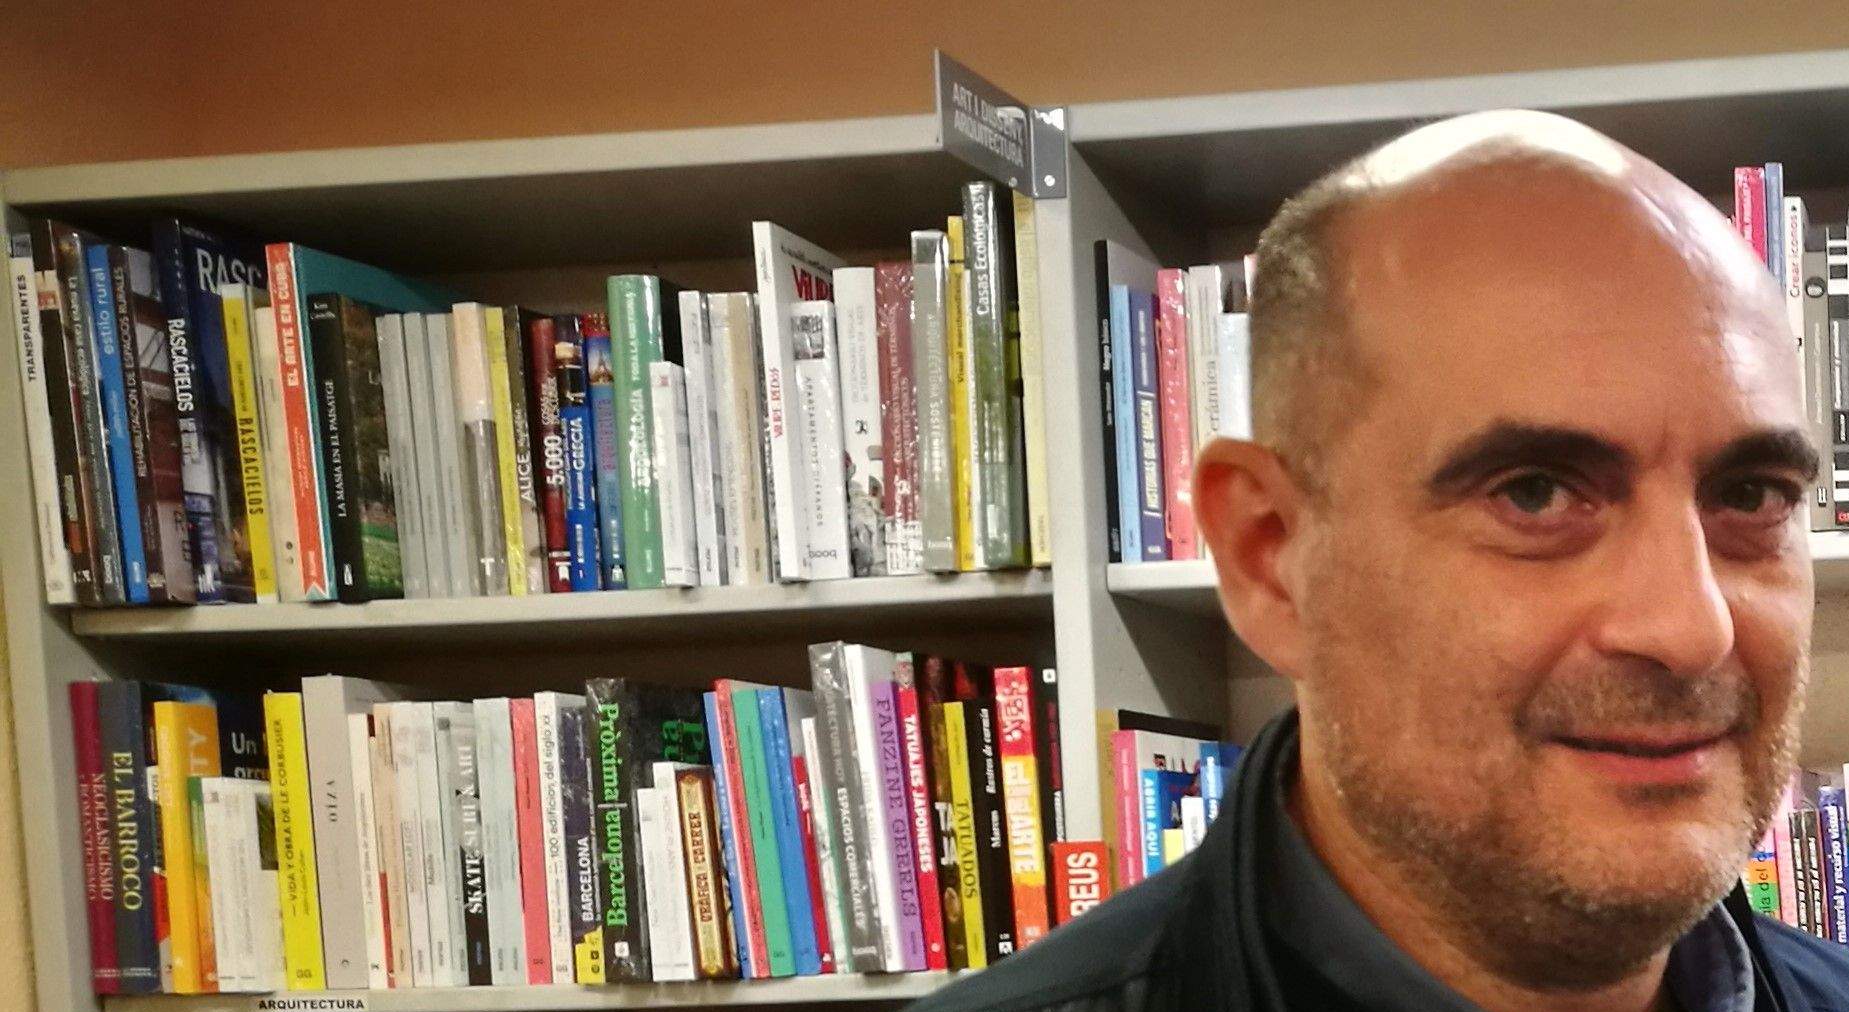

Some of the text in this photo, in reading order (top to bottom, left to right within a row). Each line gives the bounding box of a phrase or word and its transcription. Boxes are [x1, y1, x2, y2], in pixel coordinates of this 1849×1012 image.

[976, 273, 990, 315] Casas
[1790, 256, 1801, 298] Crear
[17, 274, 37, 382] TRANSPARENTES
[101, 309, 116, 356] estilo
[167, 317, 195, 412] RASCACIELOS
[238, 417, 264, 516] RASCACIELOS
[543, 434, 565, 486] 5.000
[572, 416, 586, 471] GRECIA
[517, 451, 536, 504] ALICE
[875, 697, 918, 917] FANZINE GRRRLS
[903, 713, 935, 873] TATUAJES JAPONESES
[1825, 804, 1842, 840] visual
[112, 751, 143, 911] EL BARROCO
[955, 799, 977, 900] TATUADOS
[582, 836, 595, 922] BARCELONA
[605, 808, 628, 927] Barcelona
[1066, 851, 1101, 916] REUS
[1829, 840, 1844, 884] recurso
[1834, 896, 1848, 944] material
[258, 998, 365, 1010] ARQUITECTURA
